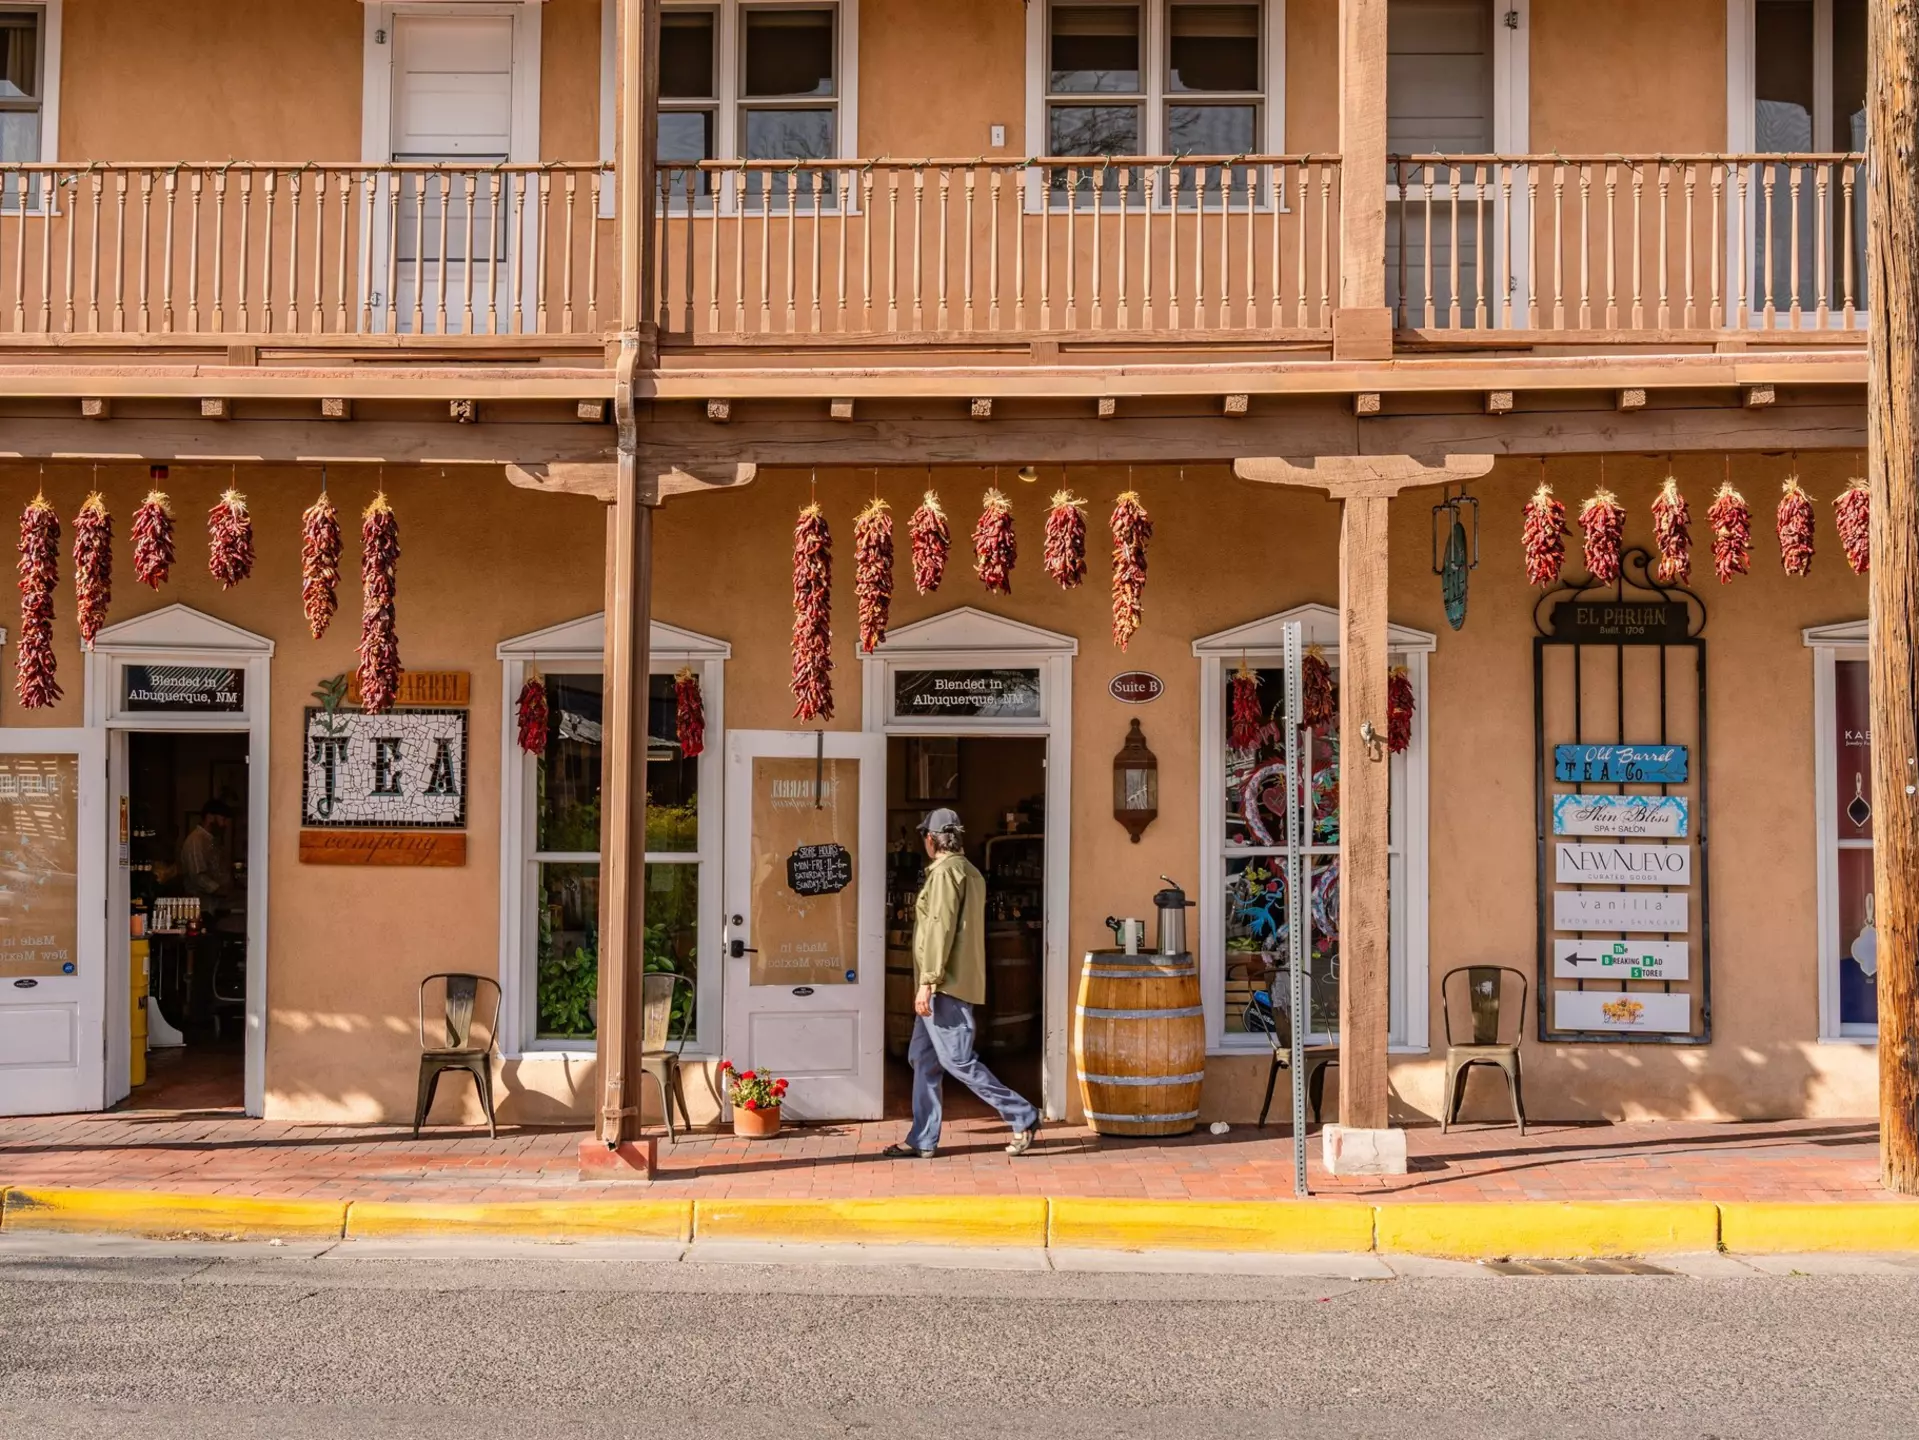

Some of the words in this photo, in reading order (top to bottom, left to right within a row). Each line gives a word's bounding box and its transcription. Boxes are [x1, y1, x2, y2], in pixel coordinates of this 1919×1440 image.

[1576, 608, 1599, 625] EL
[1604, 608, 1667, 625] PARIAN
[1625, 626, 1644, 635] 1706
[150, 675, 200, 687] Blended
[204, 676, 217, 688] in
[934, 679, 985, 690] Blended
[990, 679, 1003, 689] in
[1114, 681, 1146, 692] Suite
[1149, 681, 1158, 692] B
[128, 690, 211, 704] Albuquerque,
[215, 692, 238, 703] NM
[913, 694, 997, 707] Albuquerque,
[1002, 693, 1025, 704] NM
[1585, 747, 1613, 762] Old
[1616, 748, 1675, 763] Barrel
[311, 736, 460, 819] TEA
[1565, 762, 1609, 780] TEA
[1573, 804, 1618, 822] Skin
[1620, 804, 1669, 822] Bliss
[323, 833, 438, 862] company
[800, 846, 817, 857] STORE
[818, 845, 838, 856] HOURS
[1580, 899, 1662, 910] vanilla
[1614, 944, 1628, 954] The
[1603, 955, 1640, 966] BREAKING
[1644, 956, 1662, 966] BAD
